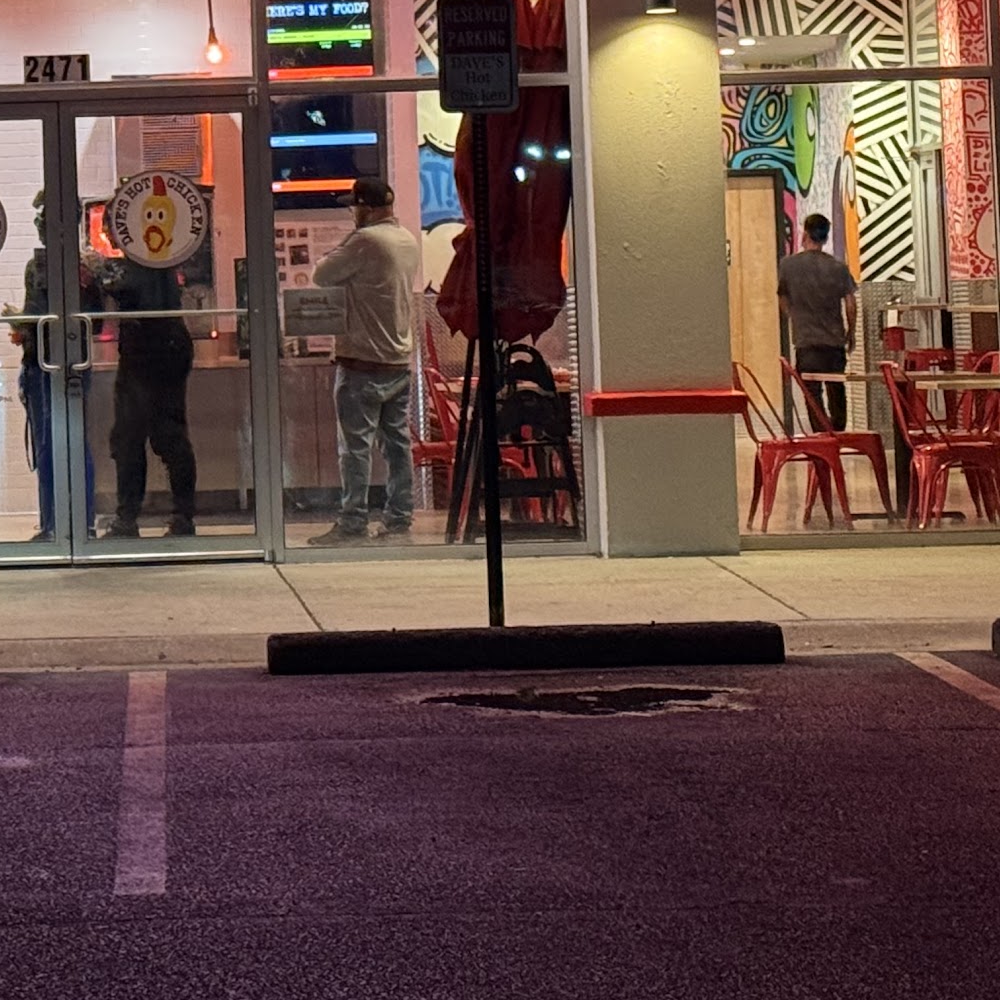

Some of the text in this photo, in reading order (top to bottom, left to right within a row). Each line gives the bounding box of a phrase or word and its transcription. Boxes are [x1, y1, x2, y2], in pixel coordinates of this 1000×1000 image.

[308, 3, 328, 16] MY
[332, 1, 369, 15] FOOD?
[444, 6, 508, 23] RESERVED
[446, 29, 506, 48] PARKING
[24, 54, 88, 83] 2471
[451, 55, 506, 71] DAVE'S
[465, 71, 491, 84] Hot
[450, 88, 507, 102] Chicken
[115, 177, 203, 247] DAVE'S HOT CHICKEN
